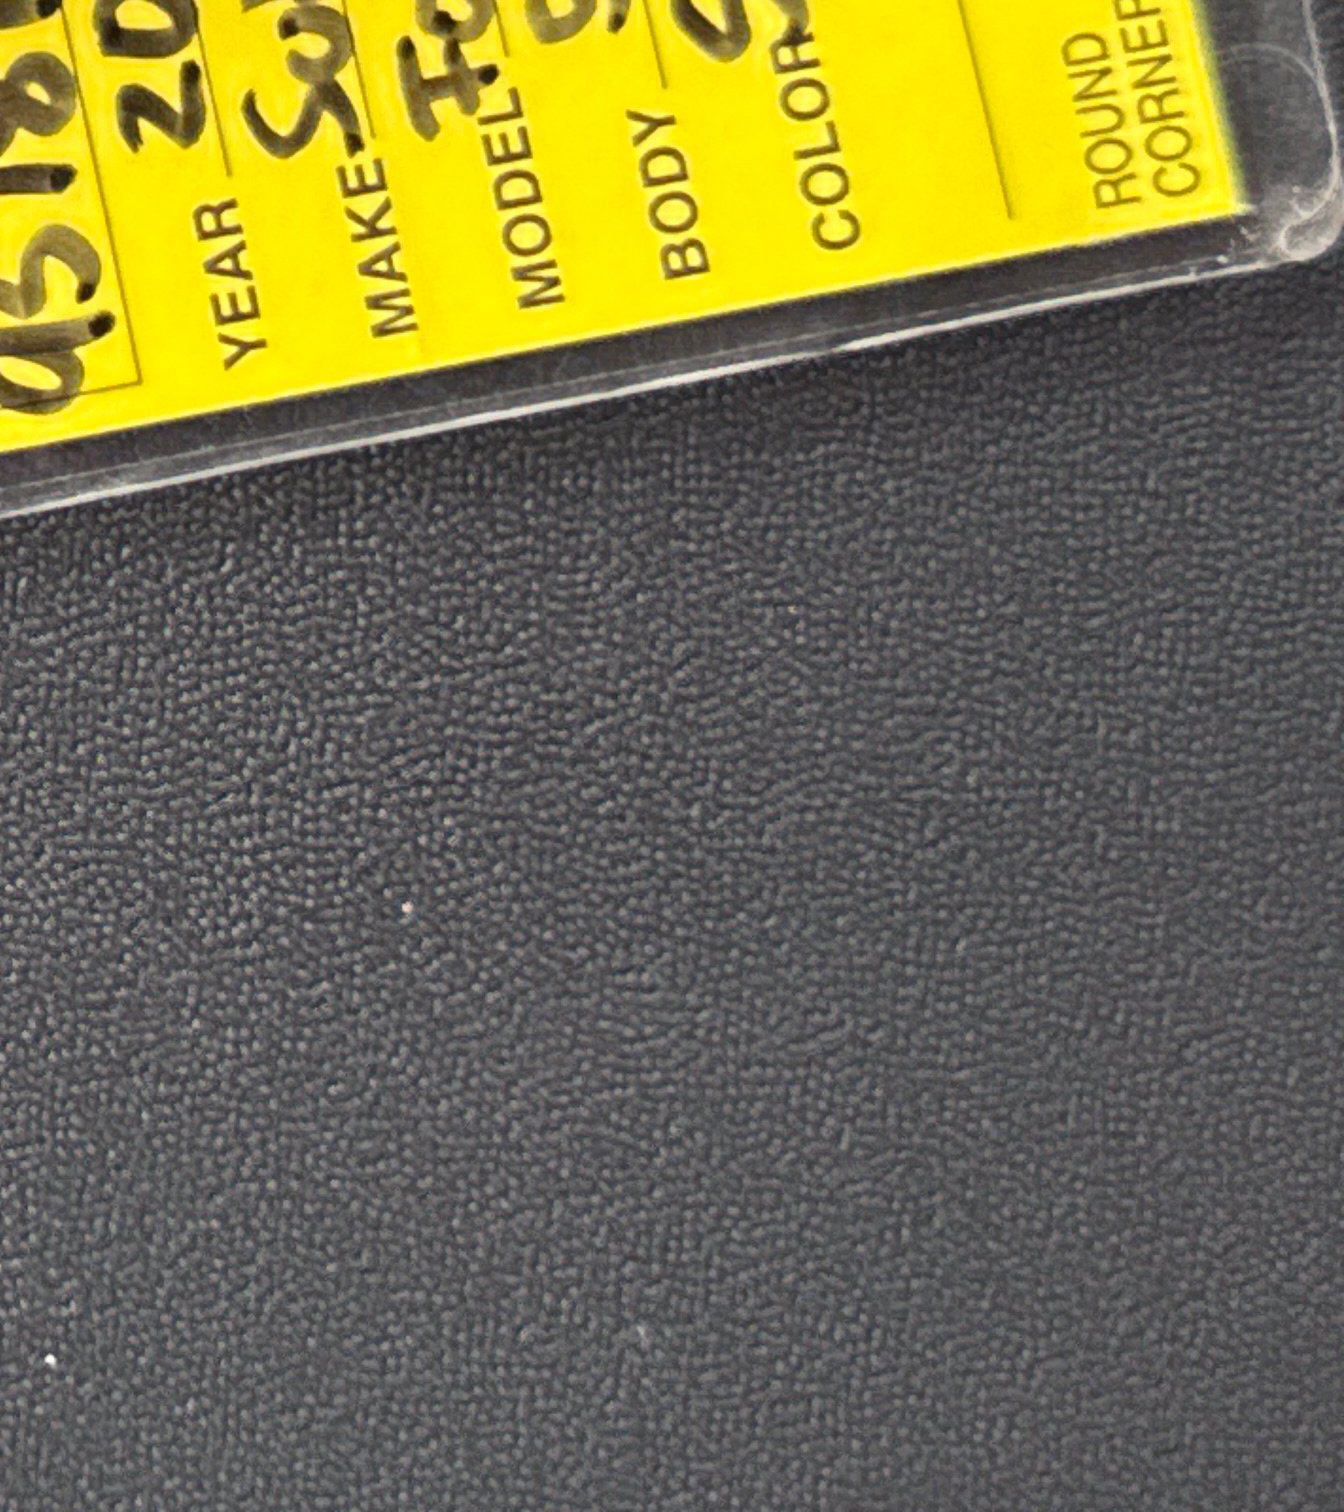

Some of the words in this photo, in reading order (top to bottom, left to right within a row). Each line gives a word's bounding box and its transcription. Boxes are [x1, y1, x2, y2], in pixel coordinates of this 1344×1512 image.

[476, 86, 566, 311] MODEL
[626, 108, 711, 280] BODY
[768, 31, 861, 253] COLOR
[1060, 31, 1143, 210] ROUND
[190, 196, 268, 372] YEAR
[335, 156, 420, 339] MAKE
